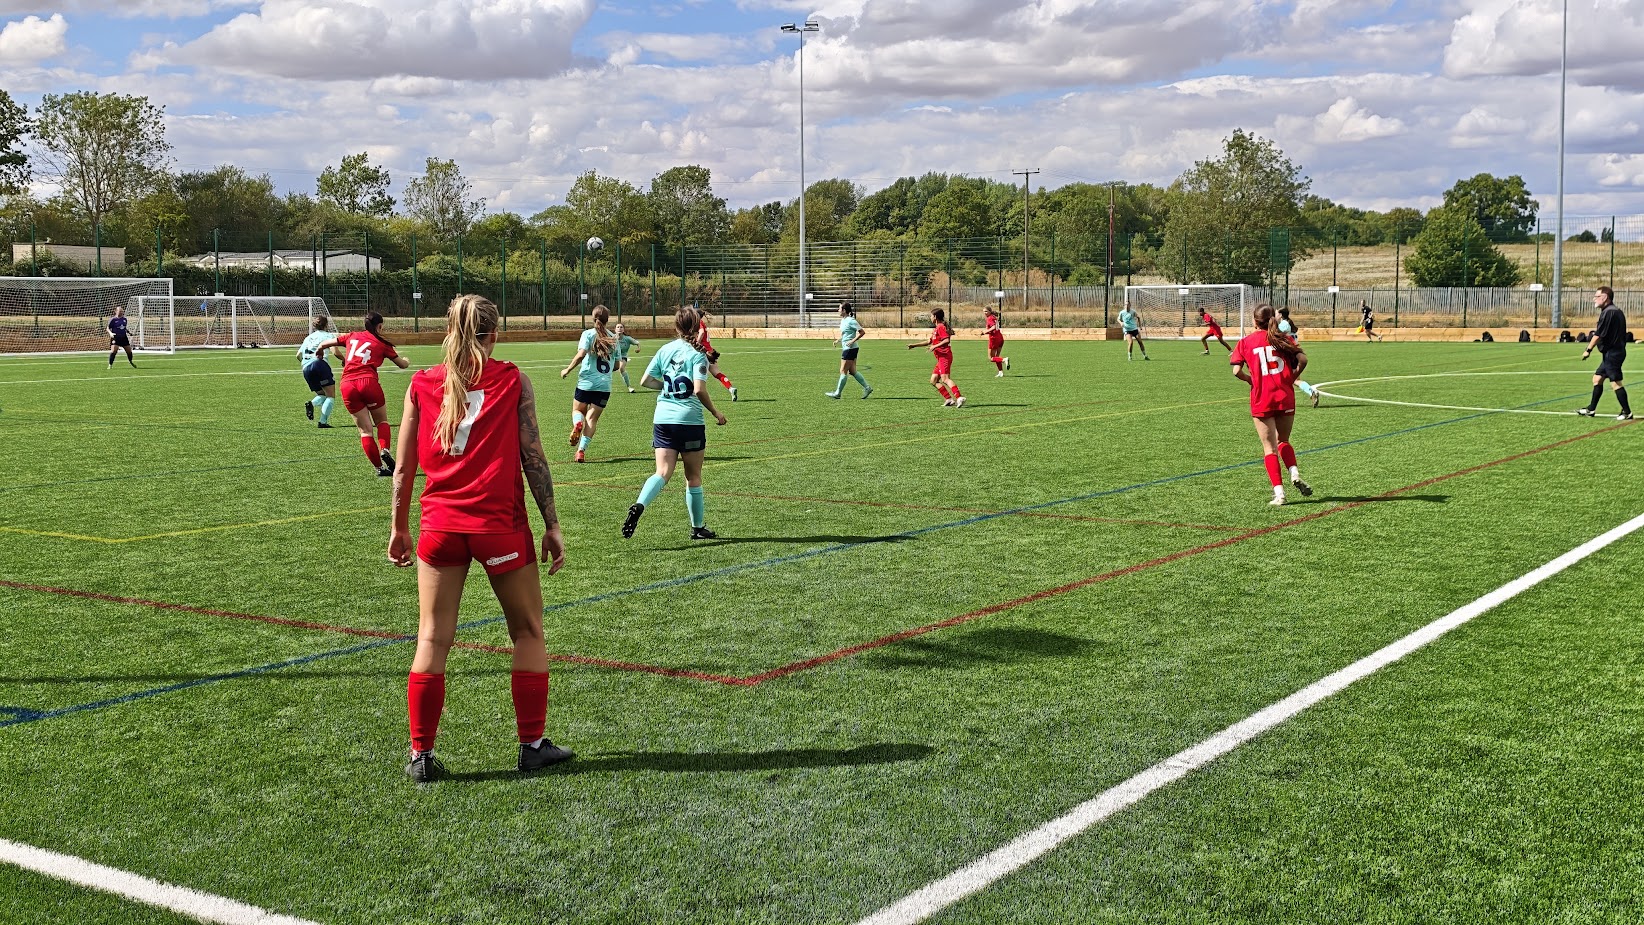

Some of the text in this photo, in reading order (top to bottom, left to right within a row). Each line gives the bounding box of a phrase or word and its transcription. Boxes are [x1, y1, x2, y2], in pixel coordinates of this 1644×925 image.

[347, 339, 371, 365] 14
[597, 353, 610, 373] 6
[1253, 345, 1285, 376] 15
[449, 389, 485, 455] 7
